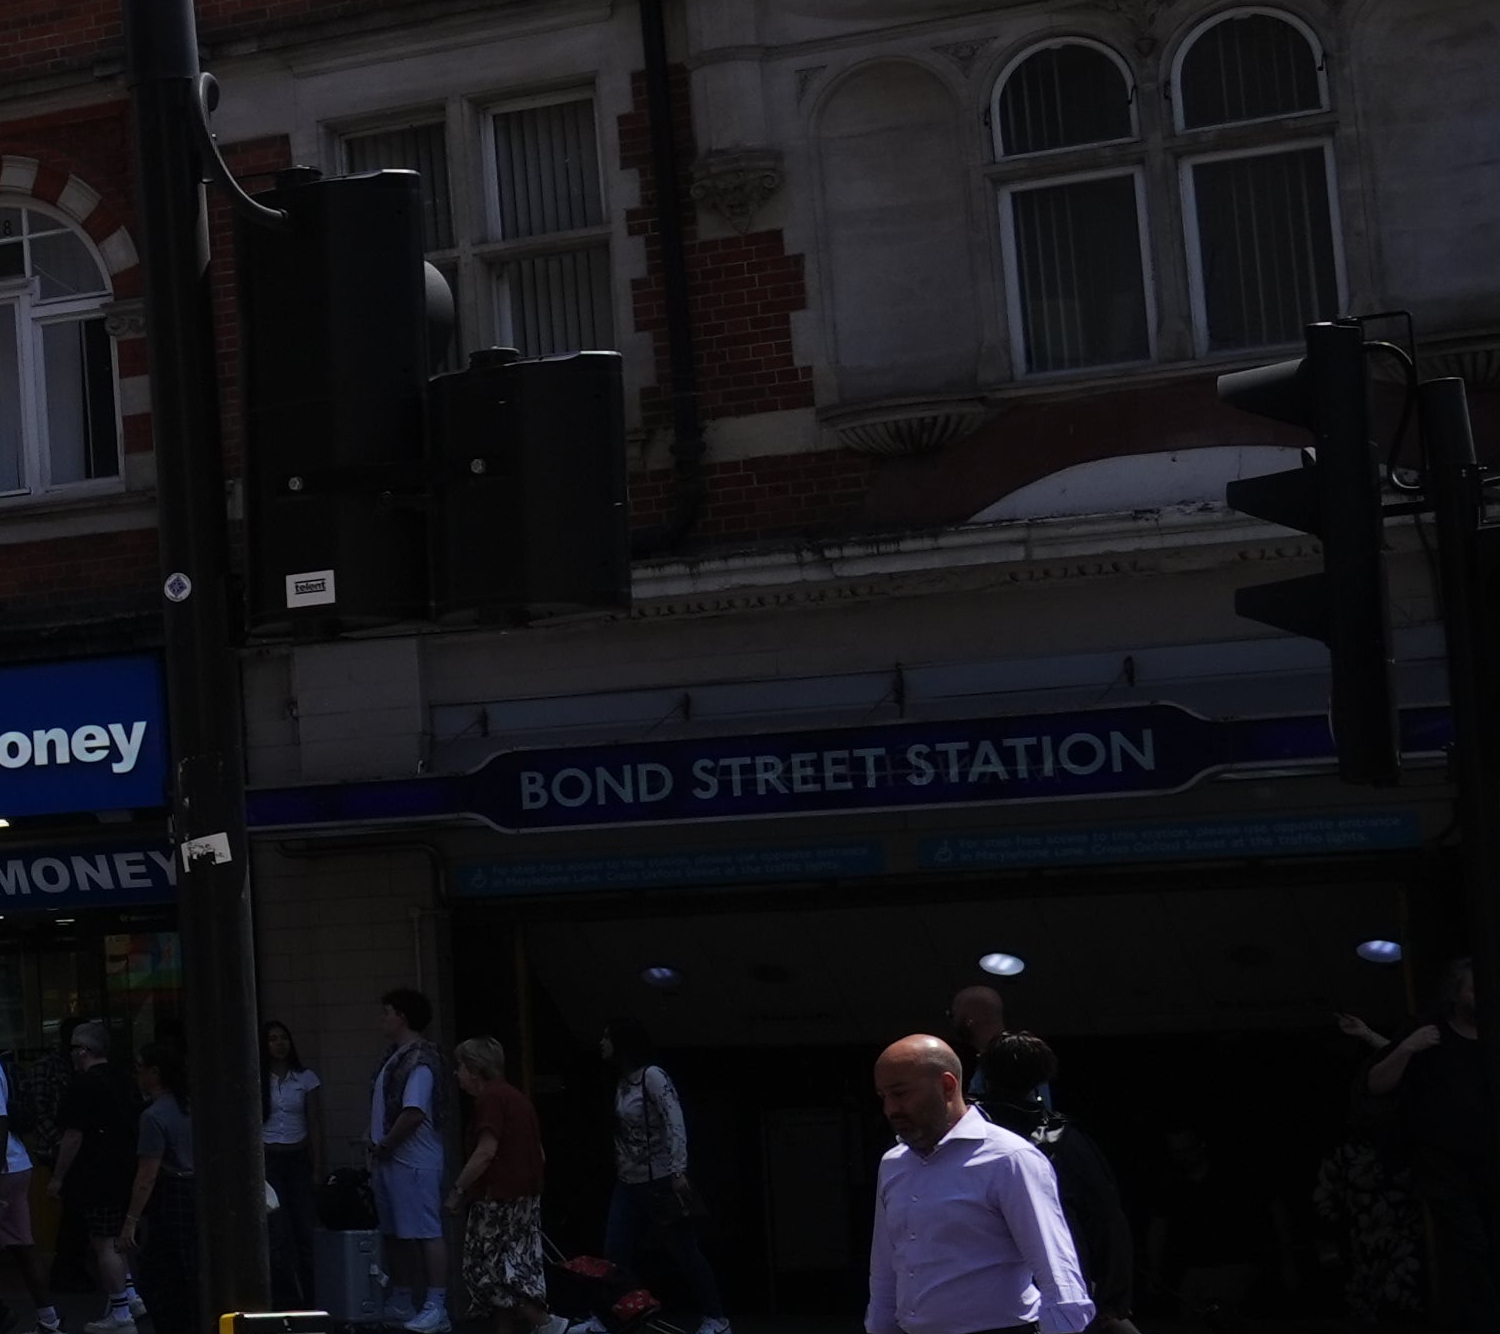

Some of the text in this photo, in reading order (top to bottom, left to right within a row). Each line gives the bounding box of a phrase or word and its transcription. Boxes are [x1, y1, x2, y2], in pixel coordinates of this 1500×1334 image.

[519, 727, 1157, 811] BOND STREET STATION
